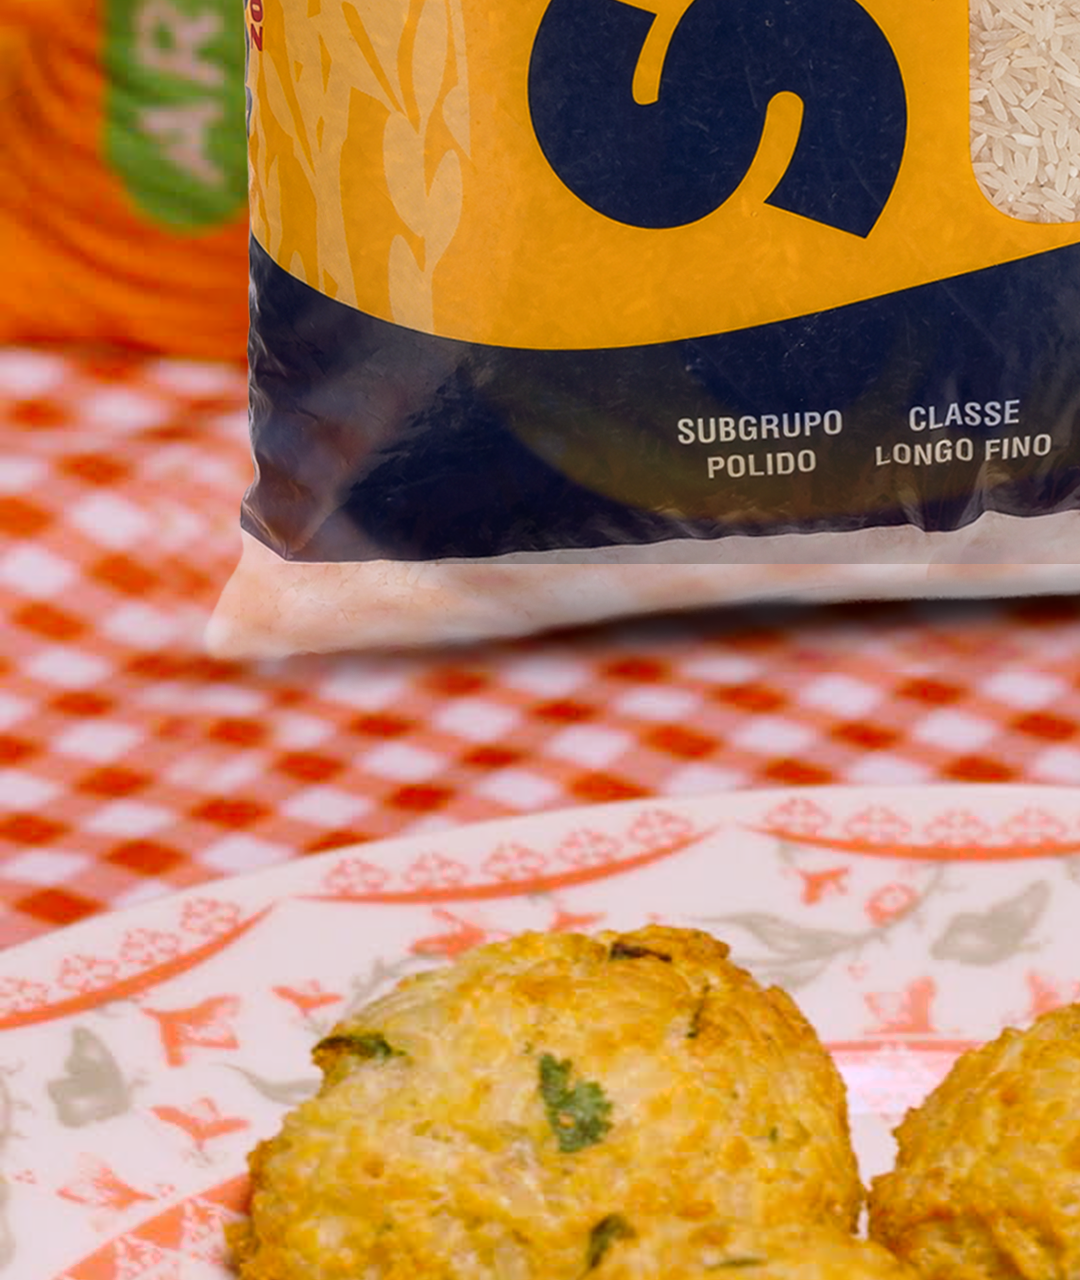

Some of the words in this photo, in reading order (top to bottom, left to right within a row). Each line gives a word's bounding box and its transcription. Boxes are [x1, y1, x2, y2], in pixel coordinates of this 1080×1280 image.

[676, 409, 843, 445] SUBGRUPO
[909, 398, 1021, 432] CLASSE
[706, 448, 818, 479] POLIDO
[874, 437, 974, 467] LONGO
[983, 432, 1053, 462] FINO
